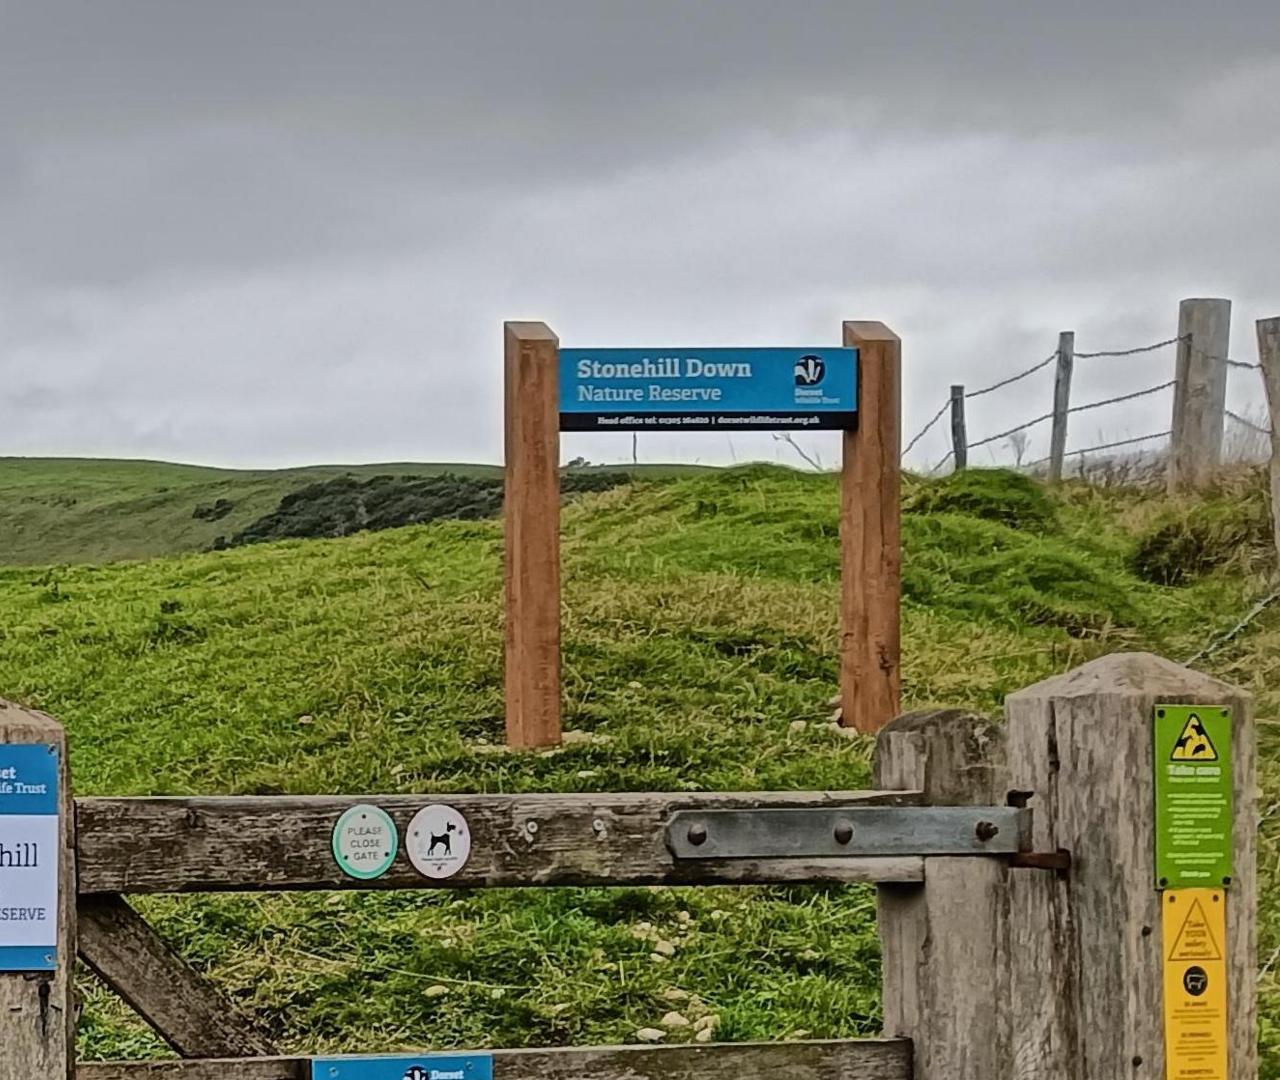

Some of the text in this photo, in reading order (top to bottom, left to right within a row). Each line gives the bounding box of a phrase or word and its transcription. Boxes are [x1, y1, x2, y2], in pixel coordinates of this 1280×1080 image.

[577, 358, 753, 378] Stonehill Down
[578, 384, 722, 401] Nature Reserve
[16, 782, 47, 795] Trust
[347, 827, 382, 836] PLEASE
[350, 839, 380, 848] CLOSE
[353, 852, 378, 861] GATE
